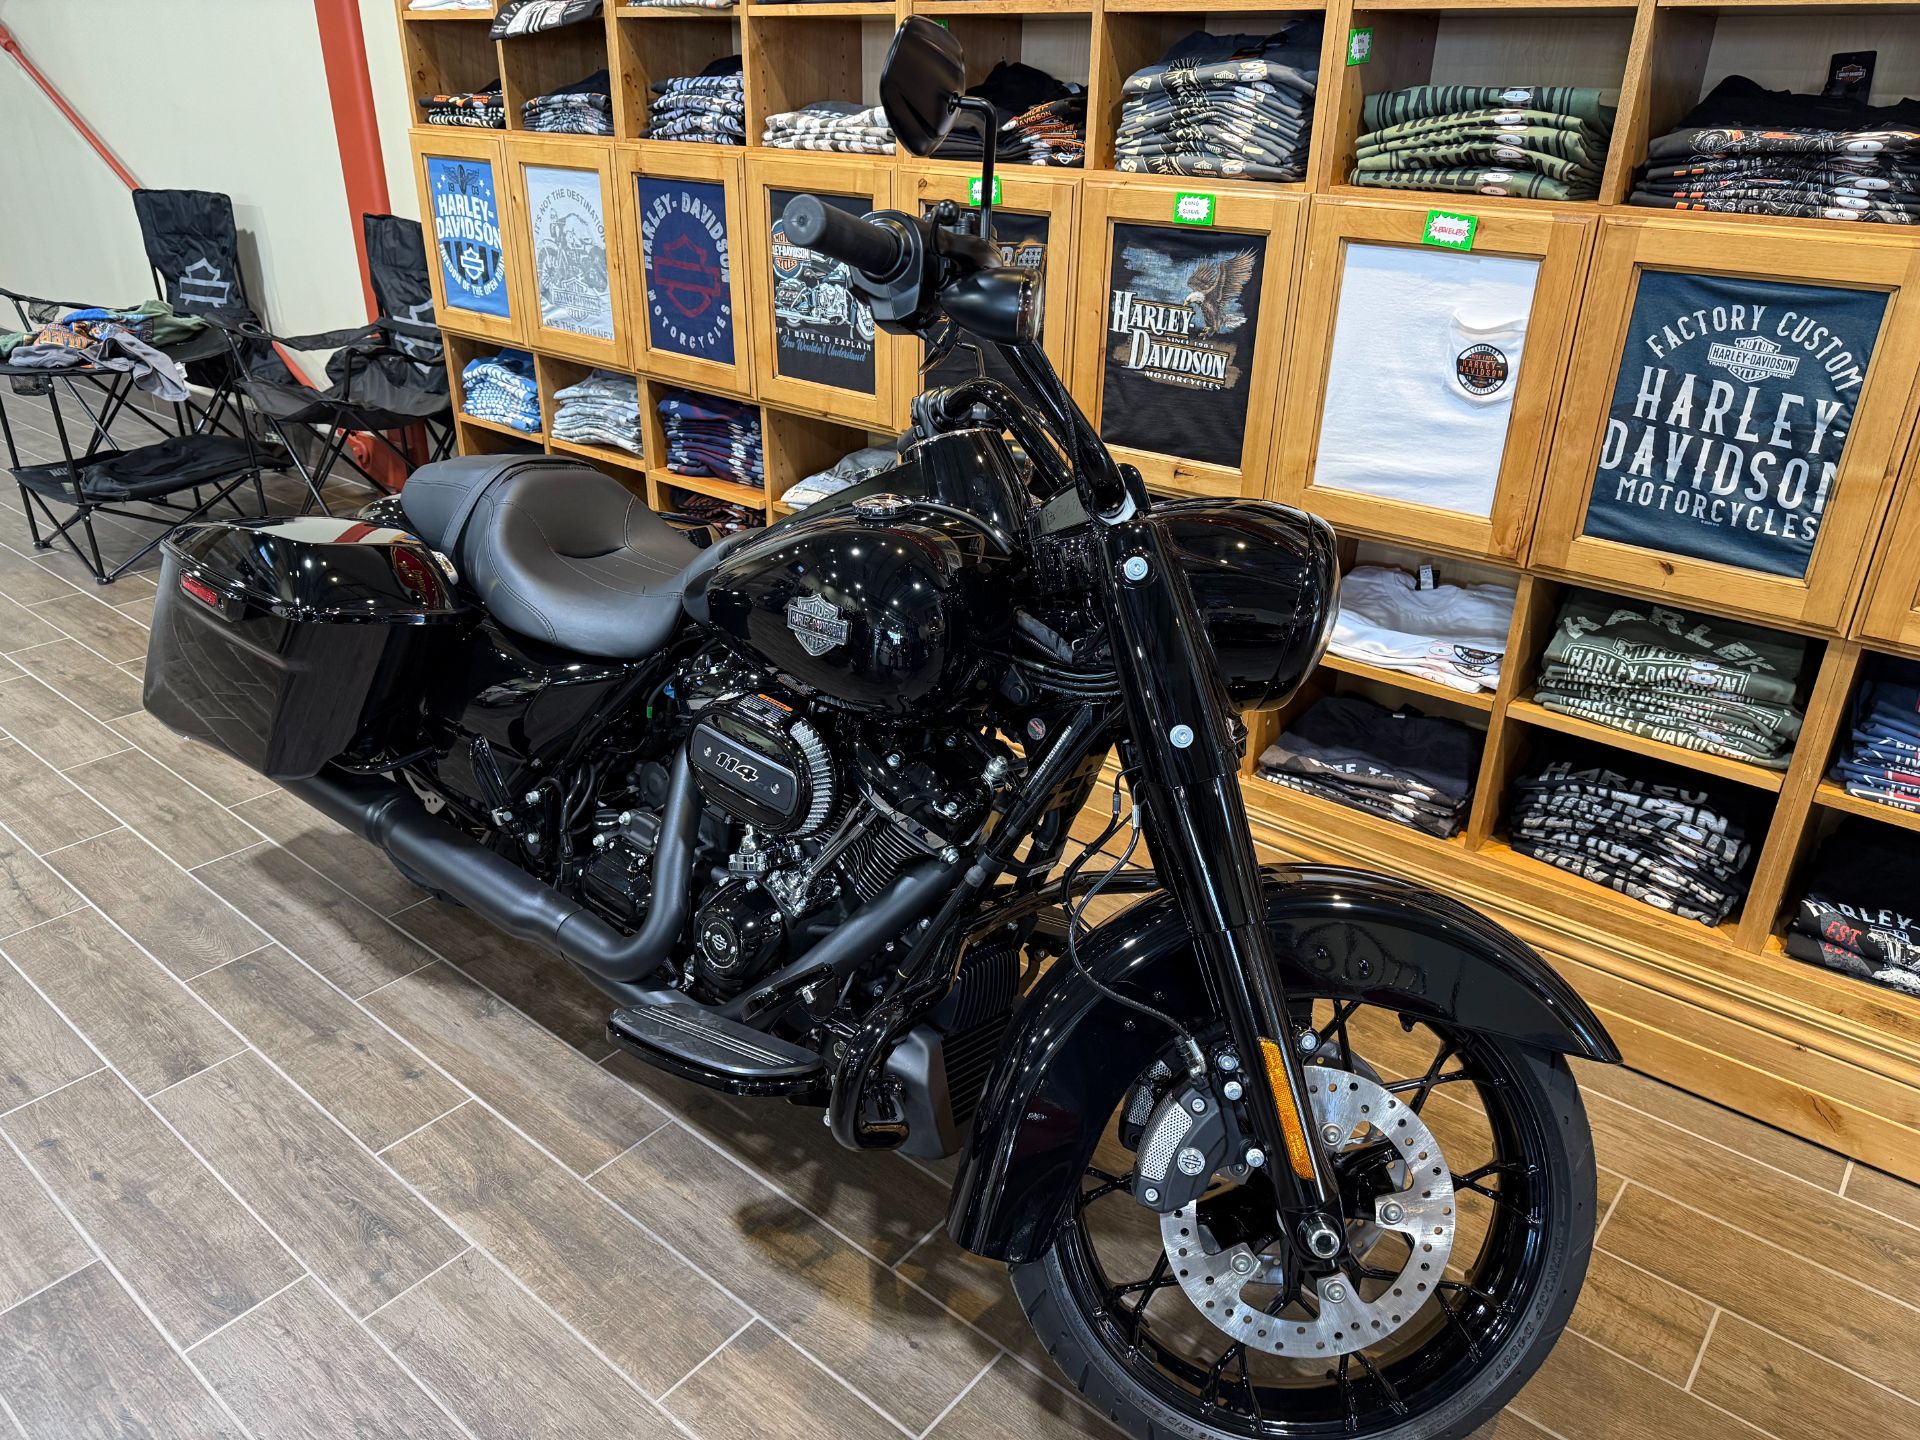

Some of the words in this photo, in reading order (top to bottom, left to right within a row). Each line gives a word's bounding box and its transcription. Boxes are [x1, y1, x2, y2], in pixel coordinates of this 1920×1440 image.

[437, 194, 495, 222] HARLEY-
[538, 194, 552, 212] NOT
[551, 188, 566, 201] THE
[435, 216, 503, 250] DAVIDSON
[681, 191, 731, 284] DAVIDSON
[462, 279, 471, 292] OF
[471, 285, 484, 297] THE
[483, 279, 499, 296] OPEN
[647, 289, 731, 350] MOTORCYCLES
[1109, 290, 1195, 336] HARLEY-
[562, 322, 577, 333] THE
[780, 335, 796, 349] You
[794, 331, 816, 341] HAVE
[819, 335, 830, 343] TO
[834, 338, 872, 352] EXPLAIN
[1121, 328, 1229, 379] DAVIDSON
[1166, 336, 1190, 346] SINCE
[1645, 304, 1767, 359] FACTORY
[1776, 311, 1864, 392] CUSTOM
[1738, 338, 1775, 353] MOTOR
[1459, 365, 1503, 378] DAVIDSON
[1462, 360, 1502, 370] HARLEY-
[1712, 347, 1796, 373] HARLEY-DAVIDSON
[1731, 365, 1767, 380] CYCLES
[1144, 370, 1222, 391] MOTORCYCLES
[1632, 365, 1846, 454] HARLEY-
[1599, 418, 1838, 514] DAVIDSON
[1615, 477, 1817, 541] MOTORCYCLES
[716, 752, 759, 782] 114
